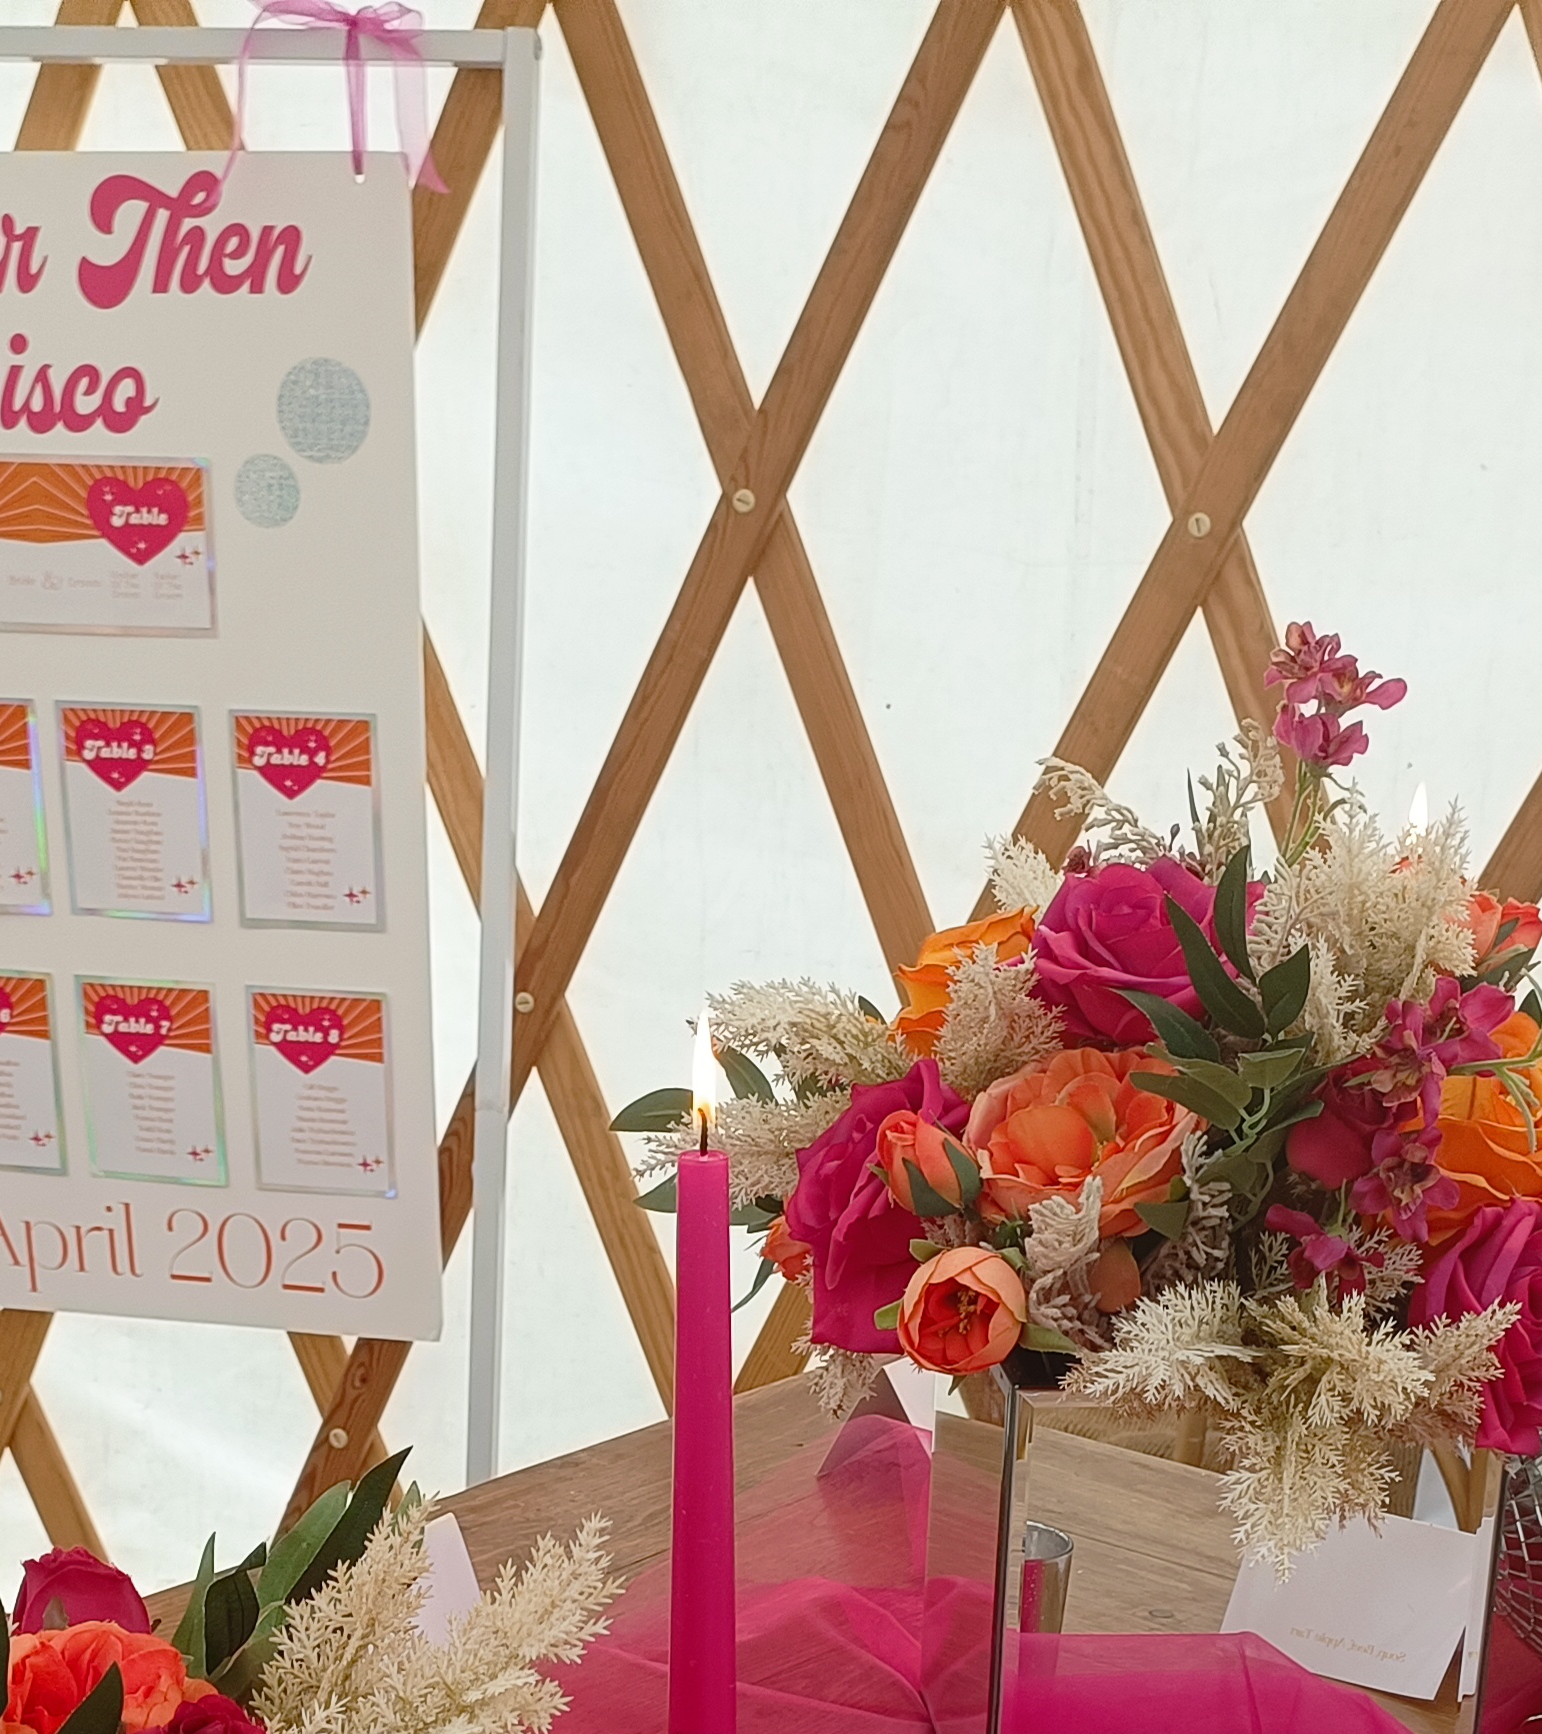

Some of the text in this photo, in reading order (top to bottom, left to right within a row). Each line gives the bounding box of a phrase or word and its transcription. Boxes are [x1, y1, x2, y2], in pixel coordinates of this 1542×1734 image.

[77, 170, 312, 309] Then
[110, 505, 169, 528] Table
[82, 740, 155, 760] Table 3
[253, 746, 327, 766] Table 4
[101, 1015, 171, 1035] Table 7
[270, 1024, 339, 1043] Table 8
[166, 1208, 384, 1298] 2025
